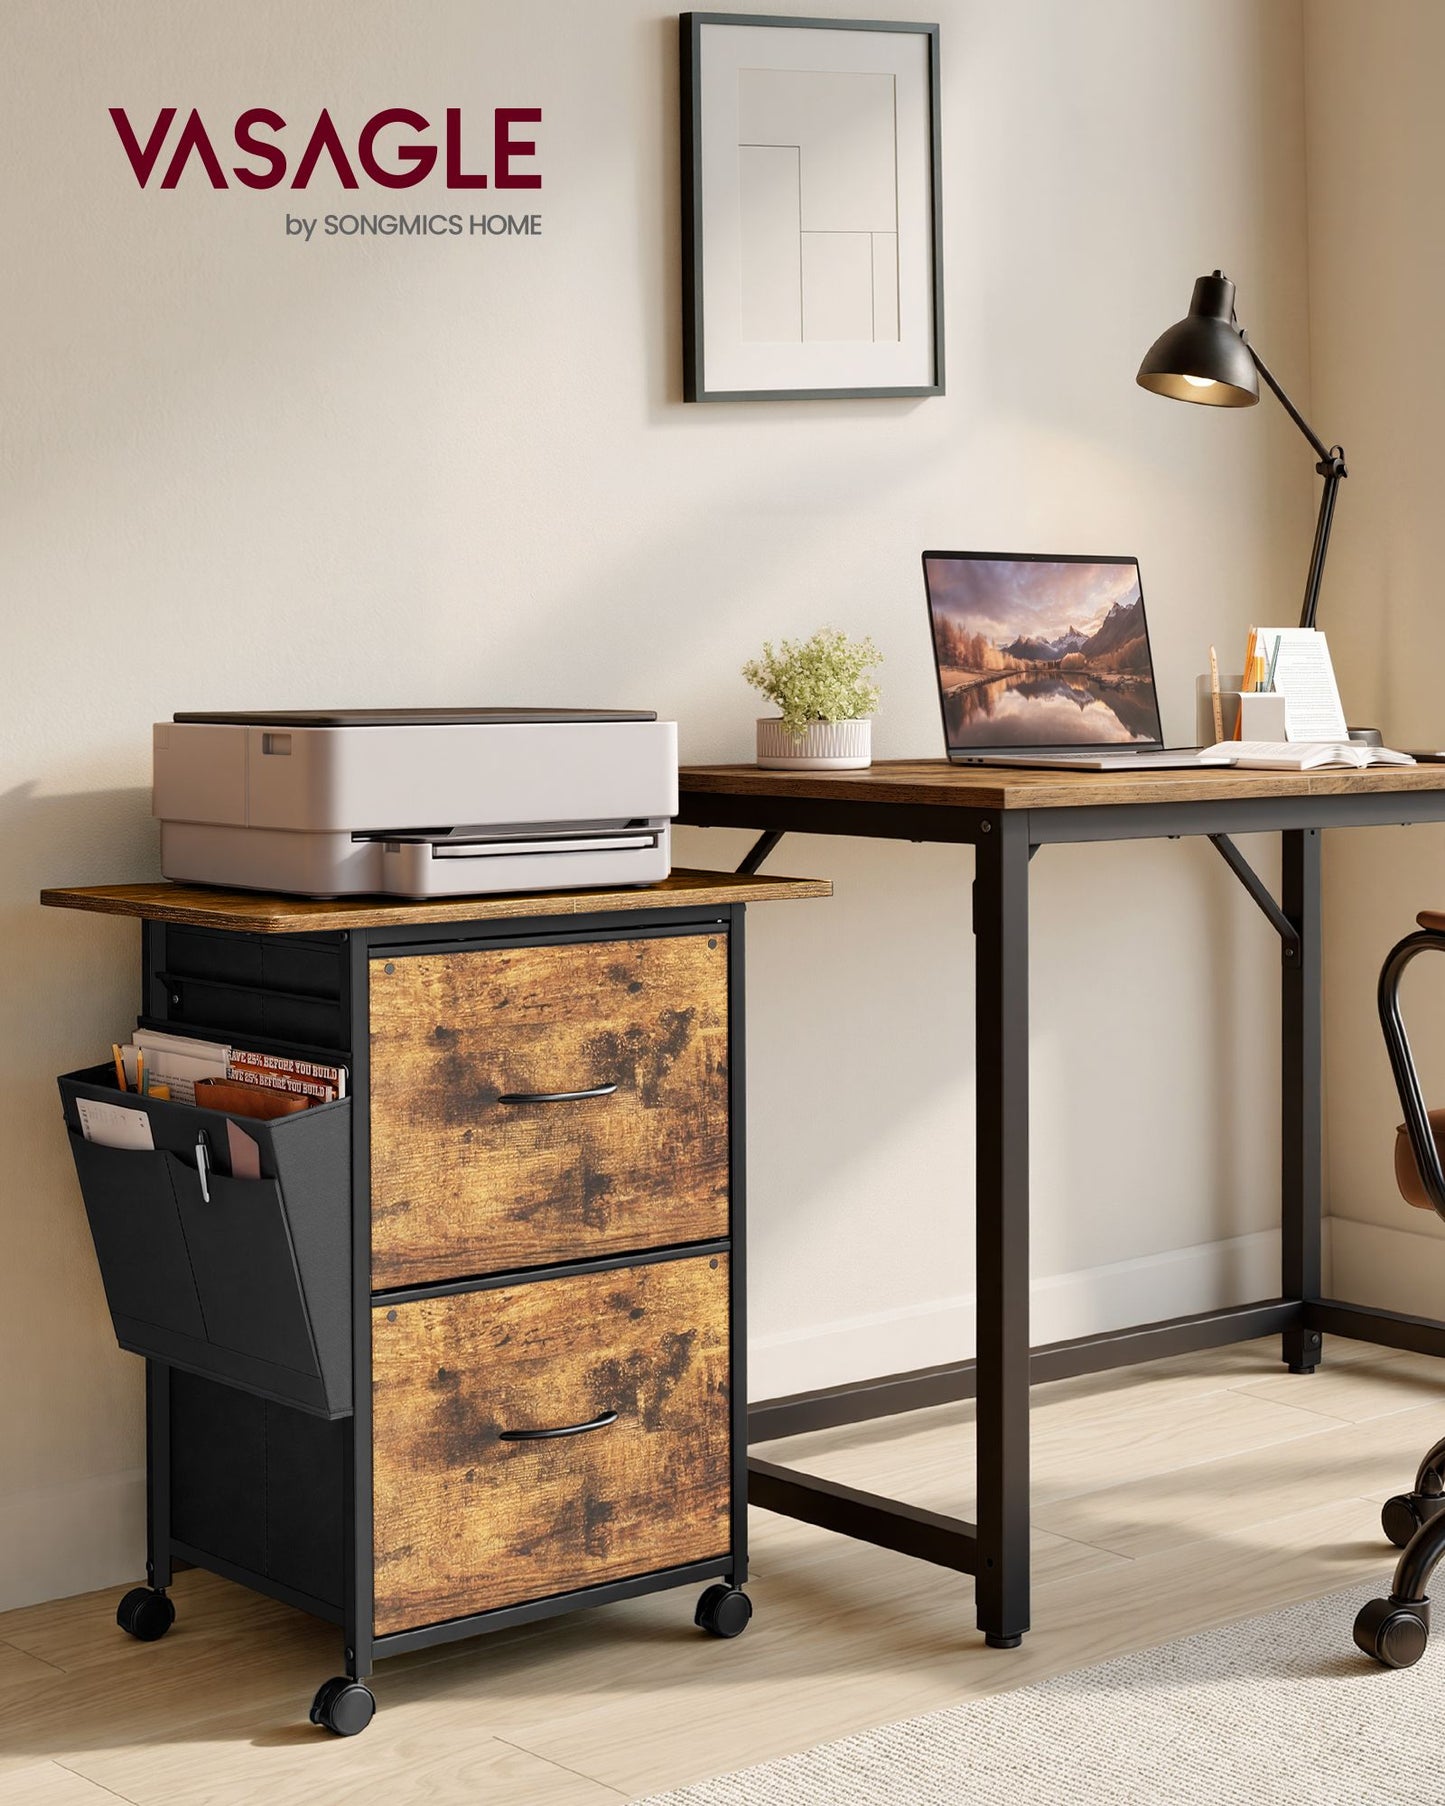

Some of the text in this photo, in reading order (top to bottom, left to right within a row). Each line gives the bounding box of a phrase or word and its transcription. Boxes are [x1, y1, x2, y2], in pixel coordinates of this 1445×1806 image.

[263, 1056, 294, 1073] BEFORE
[295, 1061, 312, 1076] YOU
[312, 1066, 338, 1080] BUILD
[259, 1075, 287, 1089] BEFORE
[287, 1079, 302, 1092] YOU
[302, 1083, 325, 1097] BUILD
